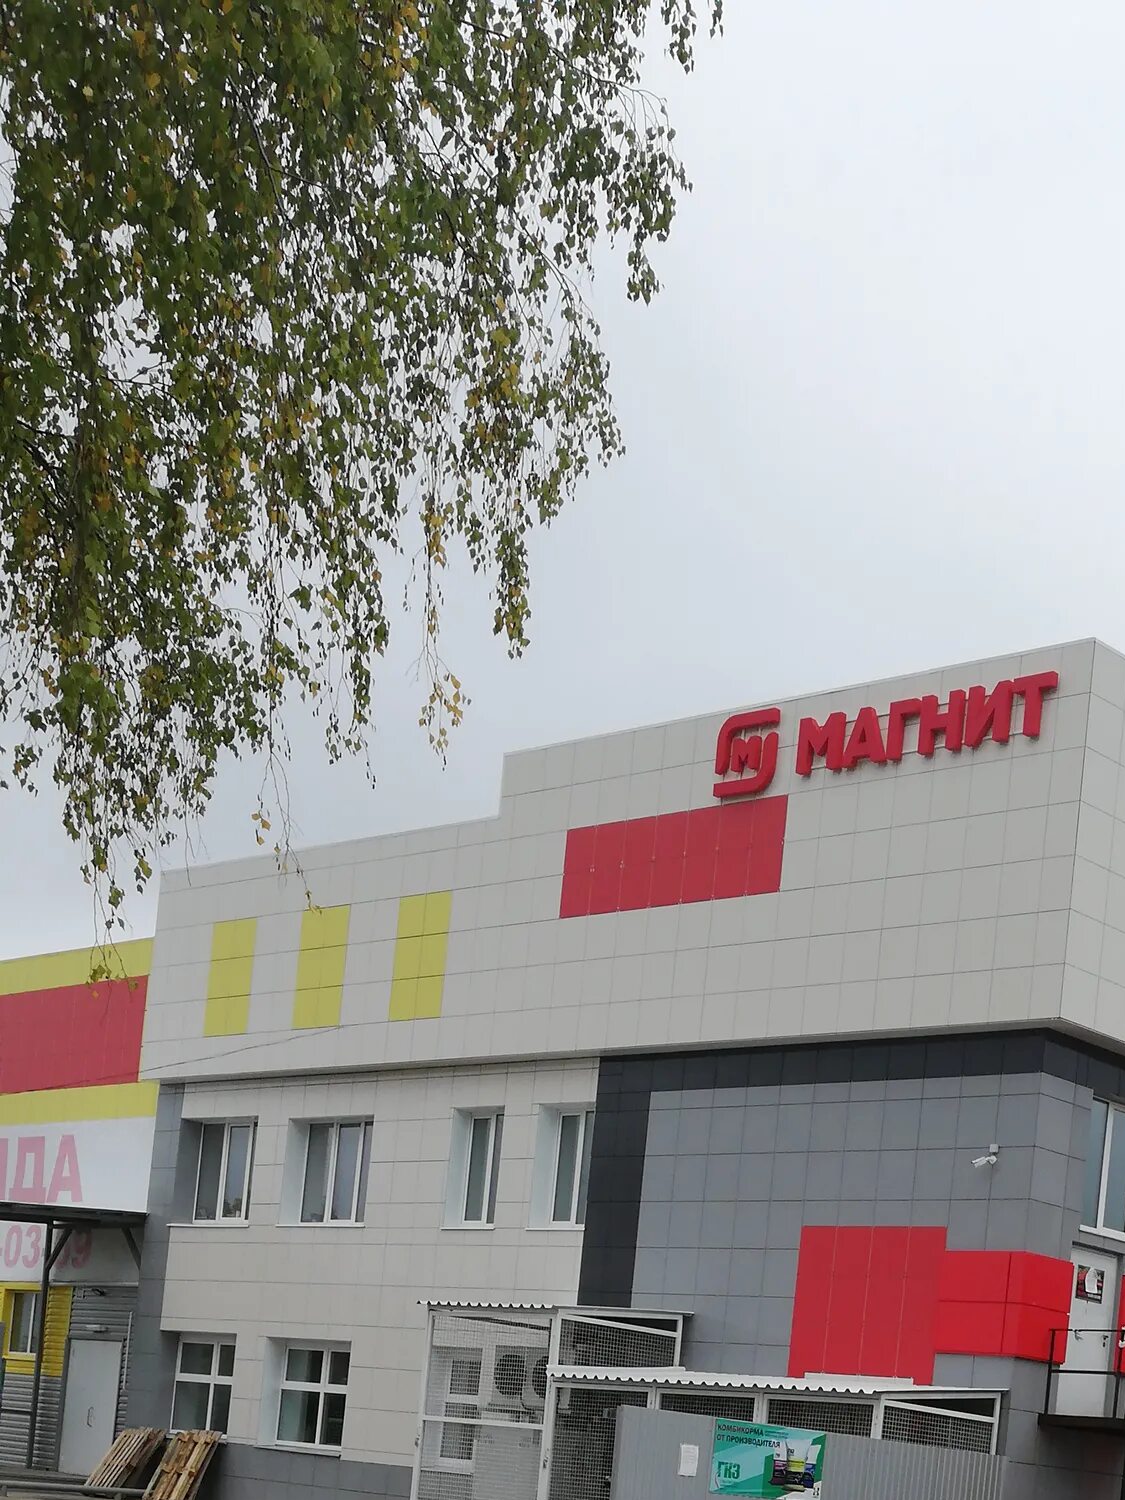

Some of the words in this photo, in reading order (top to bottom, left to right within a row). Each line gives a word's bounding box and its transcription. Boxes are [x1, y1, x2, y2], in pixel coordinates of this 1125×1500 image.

[795, 671, 1059, 776] МАГНИТ
[0, 1134, 83, 1203] ДА
[716, 1433, 725, 1441] ОТ
[726, 1436, 781, 1449] ПРОИЗВОДИТЕЛЯ
[717, 1424, 764, 1437] КОМБИКОРМА
